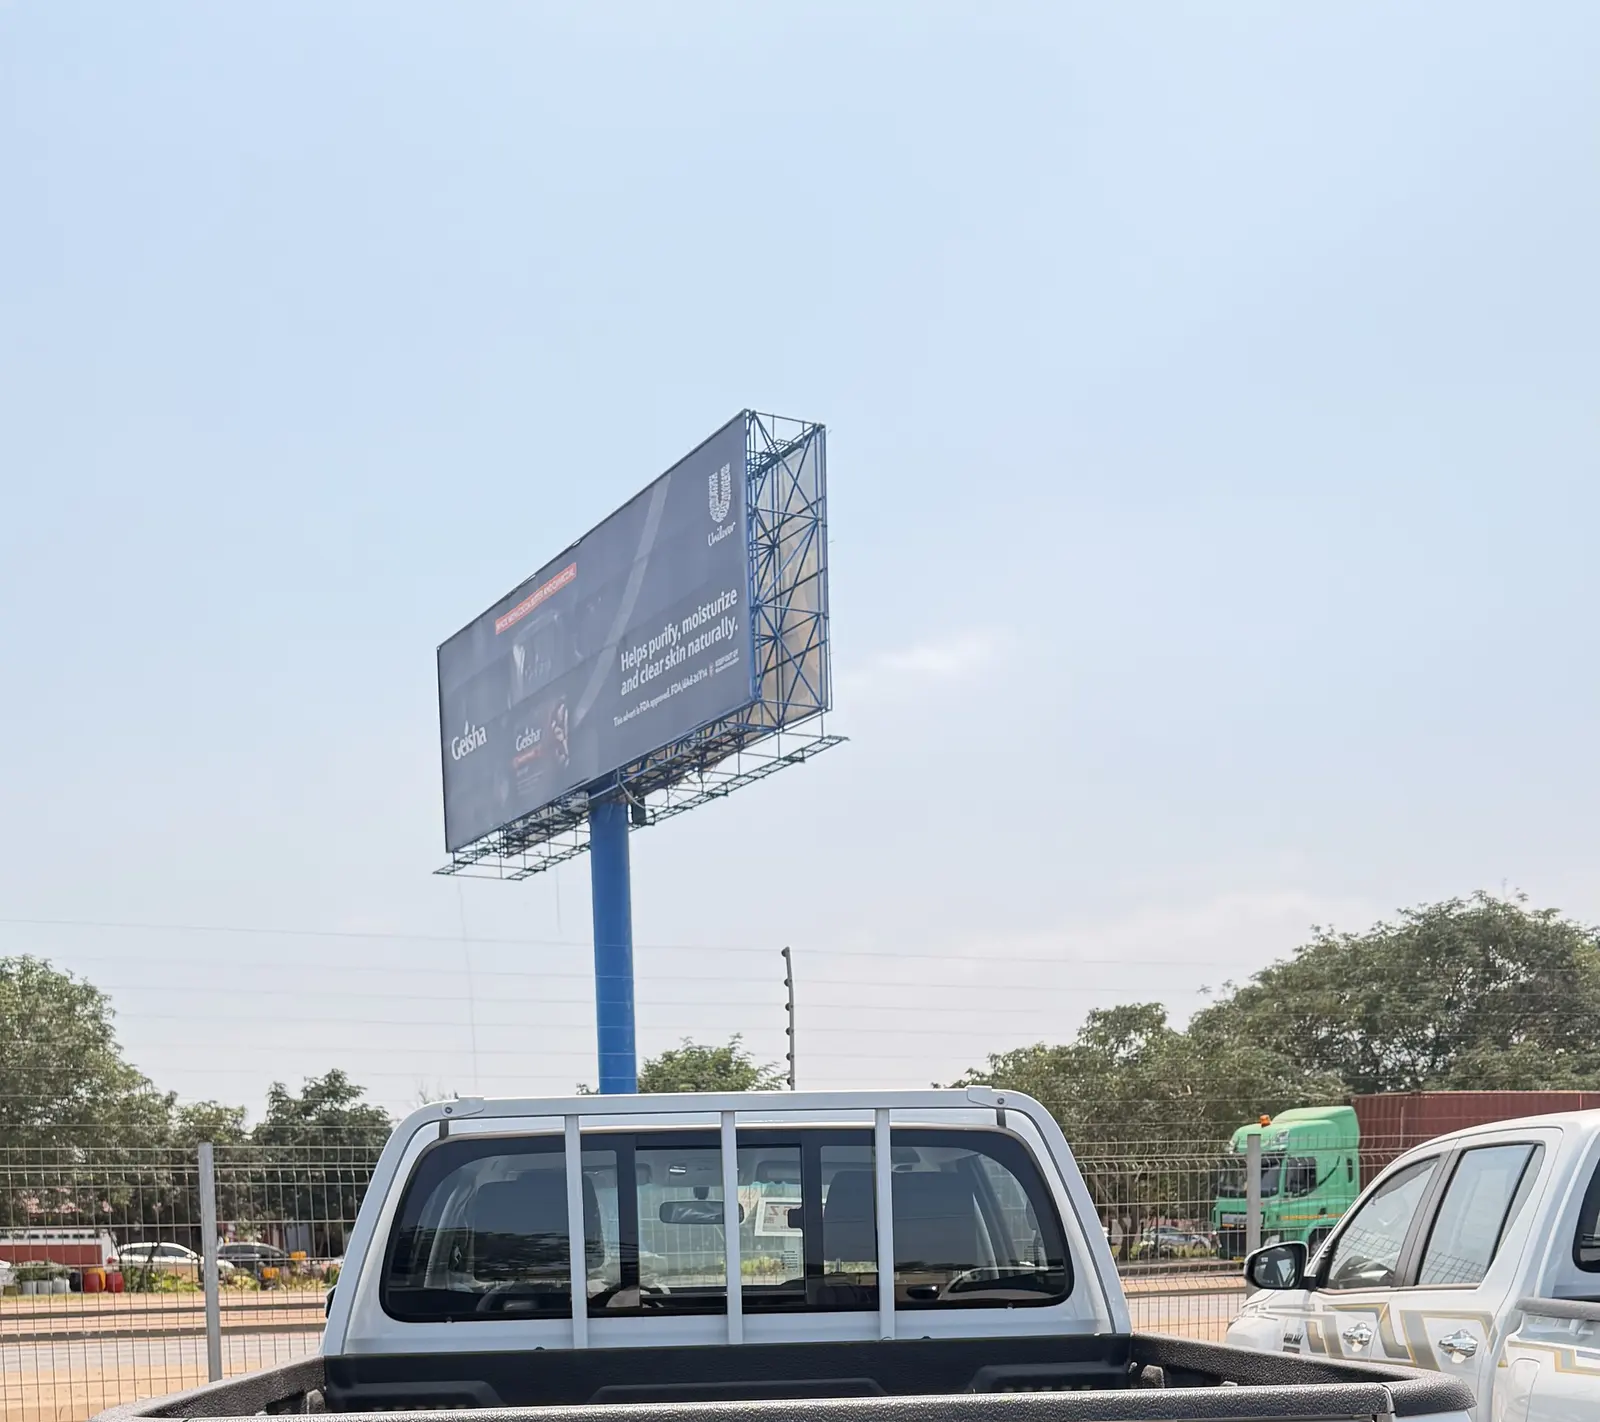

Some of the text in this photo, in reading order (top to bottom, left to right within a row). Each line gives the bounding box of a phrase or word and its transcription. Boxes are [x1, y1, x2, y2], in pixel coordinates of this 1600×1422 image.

[620, 588, 738, 672] Helps purify, moisturize
[620, 670, 639, 696] and
[640, 658, 663, 685] clear
[664, 644, 686, 671] skin
[687, 616, 739, 657] naturally.
[451, 719, 488, 761] Geisha
[515, 727, 542, 752] Geisha
